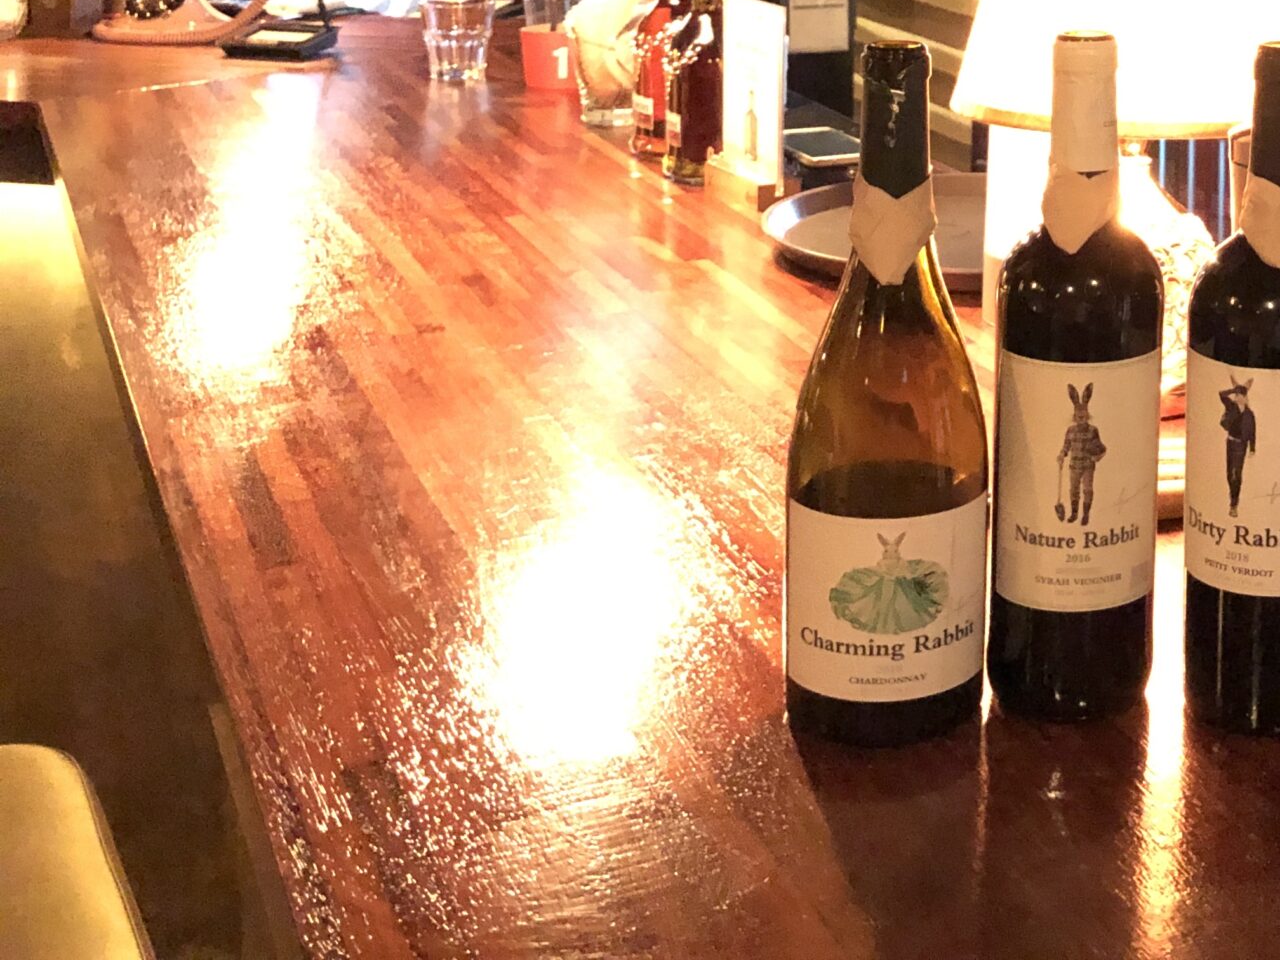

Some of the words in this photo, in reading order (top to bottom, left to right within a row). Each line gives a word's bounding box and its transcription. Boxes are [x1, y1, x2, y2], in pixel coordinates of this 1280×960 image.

[552, 46, 569, 80] 1
[1014, 524, 1076, 549] Nature
[1083, 523, 1140, 549] Rabbit
[1188, 505, 1226, 546] Dirty
[1231, 566, 1274, 578] VERDOT
[800, 626, 904, 661] Charming
[912, 619, 975, 654] Rabbit
[848, 673, 929, 685] CHARDONNAY
